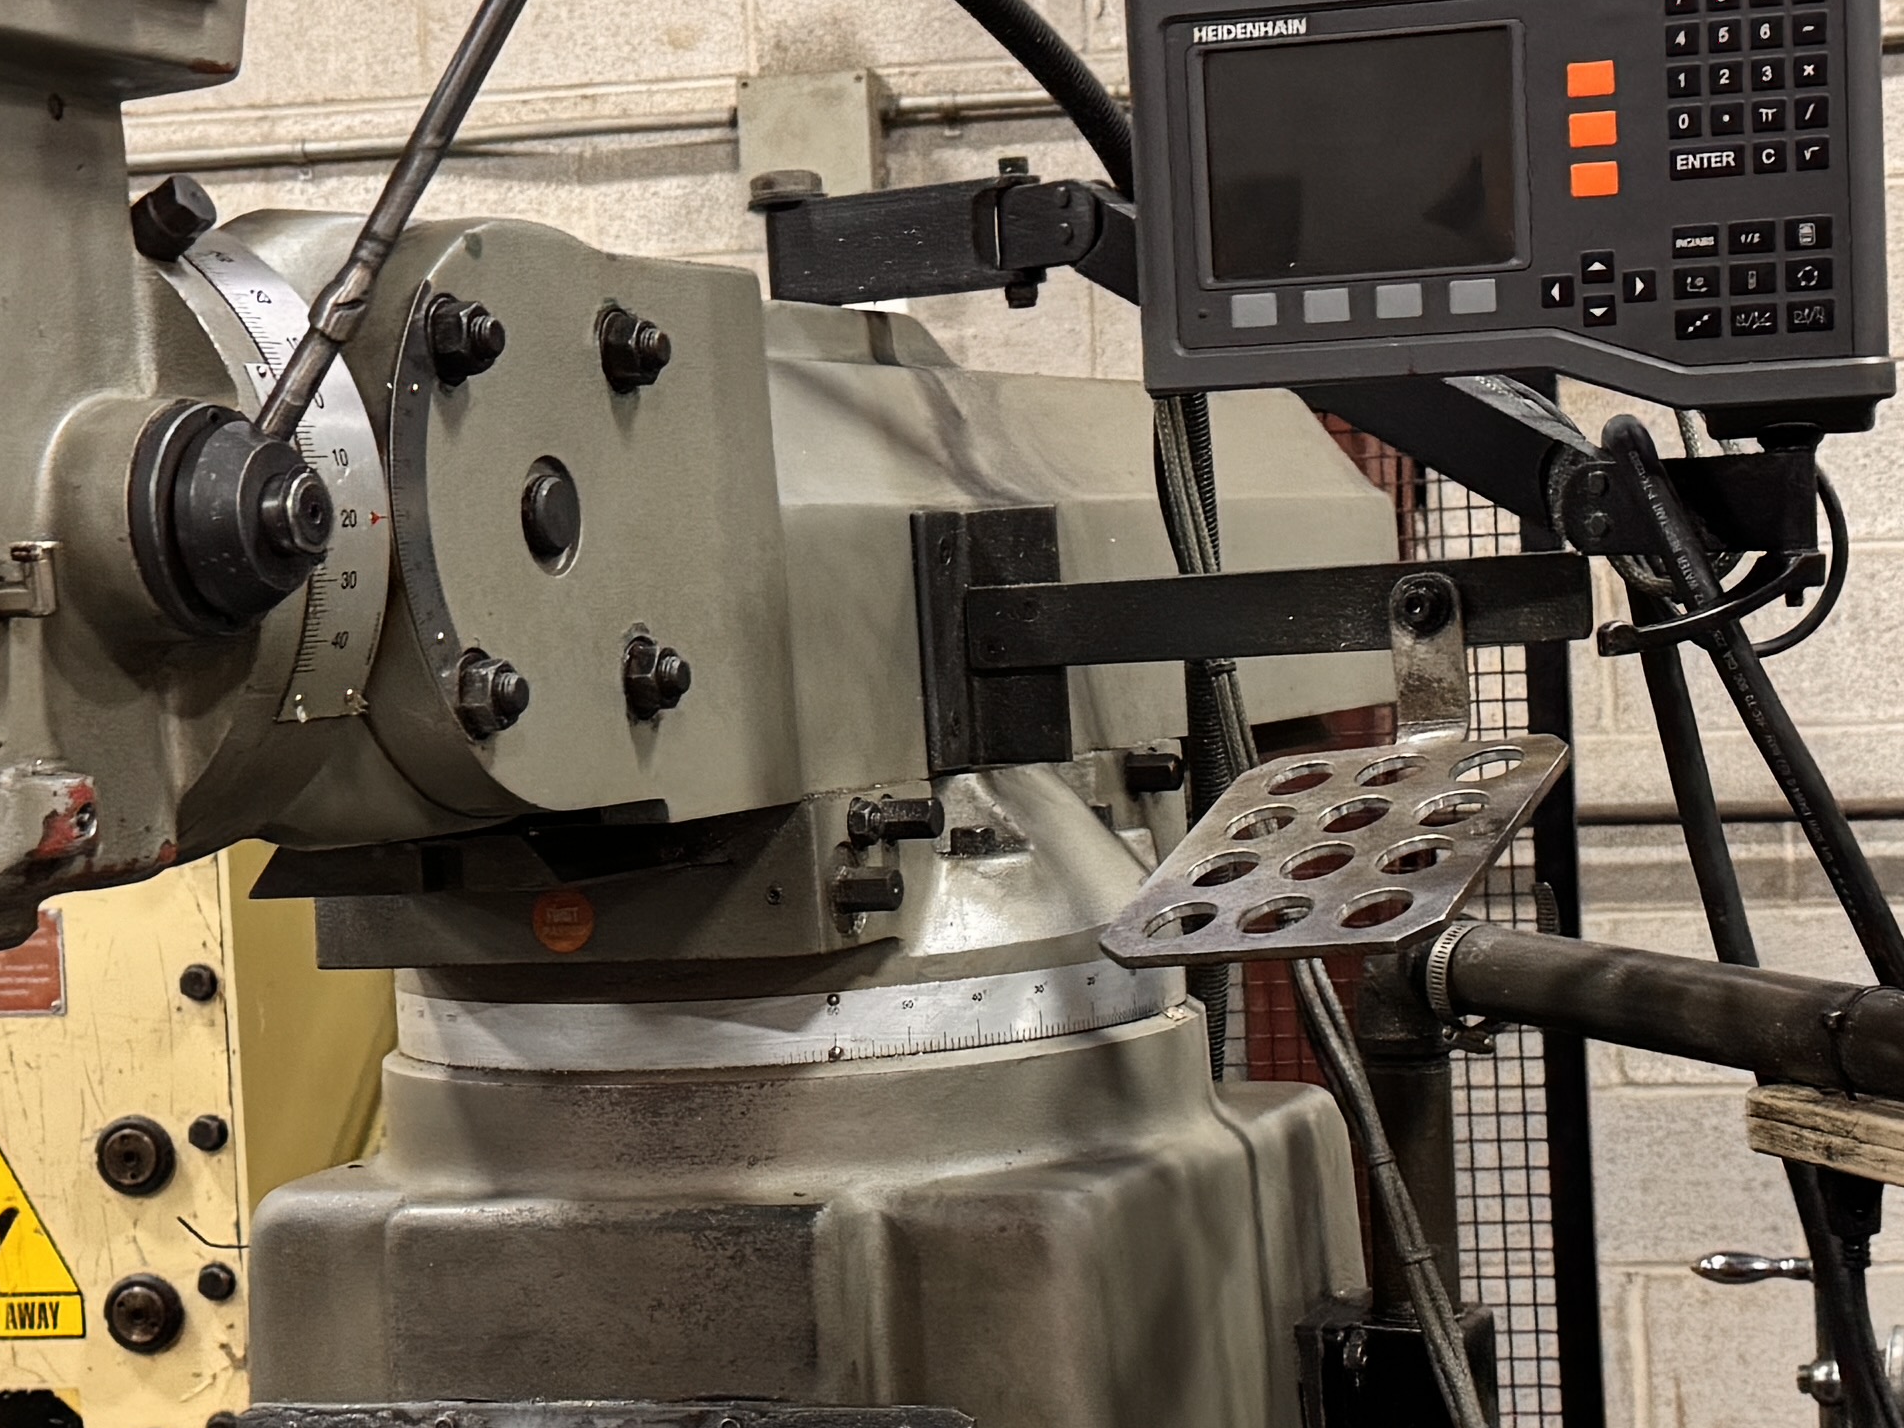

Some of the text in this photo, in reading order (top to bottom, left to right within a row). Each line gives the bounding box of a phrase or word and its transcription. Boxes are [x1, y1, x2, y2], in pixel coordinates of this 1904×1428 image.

[1193, 17, 1307, 43] HEIDENHAIN
[1674, 30, 1686, 47] 4
[1759, 23, 1770, 39] 6
[1678, 65, 1773, 88] 1 2 3
[1678, 113, 1689, 129] 0
[1676, 148, 1775, 170] ENTER C
[332, 448, 349, 466] 10
[340, 509, 357, 528] 20
[341, 571, 357, 589] 30
[1676, 557, 1700, 590] WATER
[331, 631, 349, 649] 40
[6, 1300, 60, 1330] AWAY
